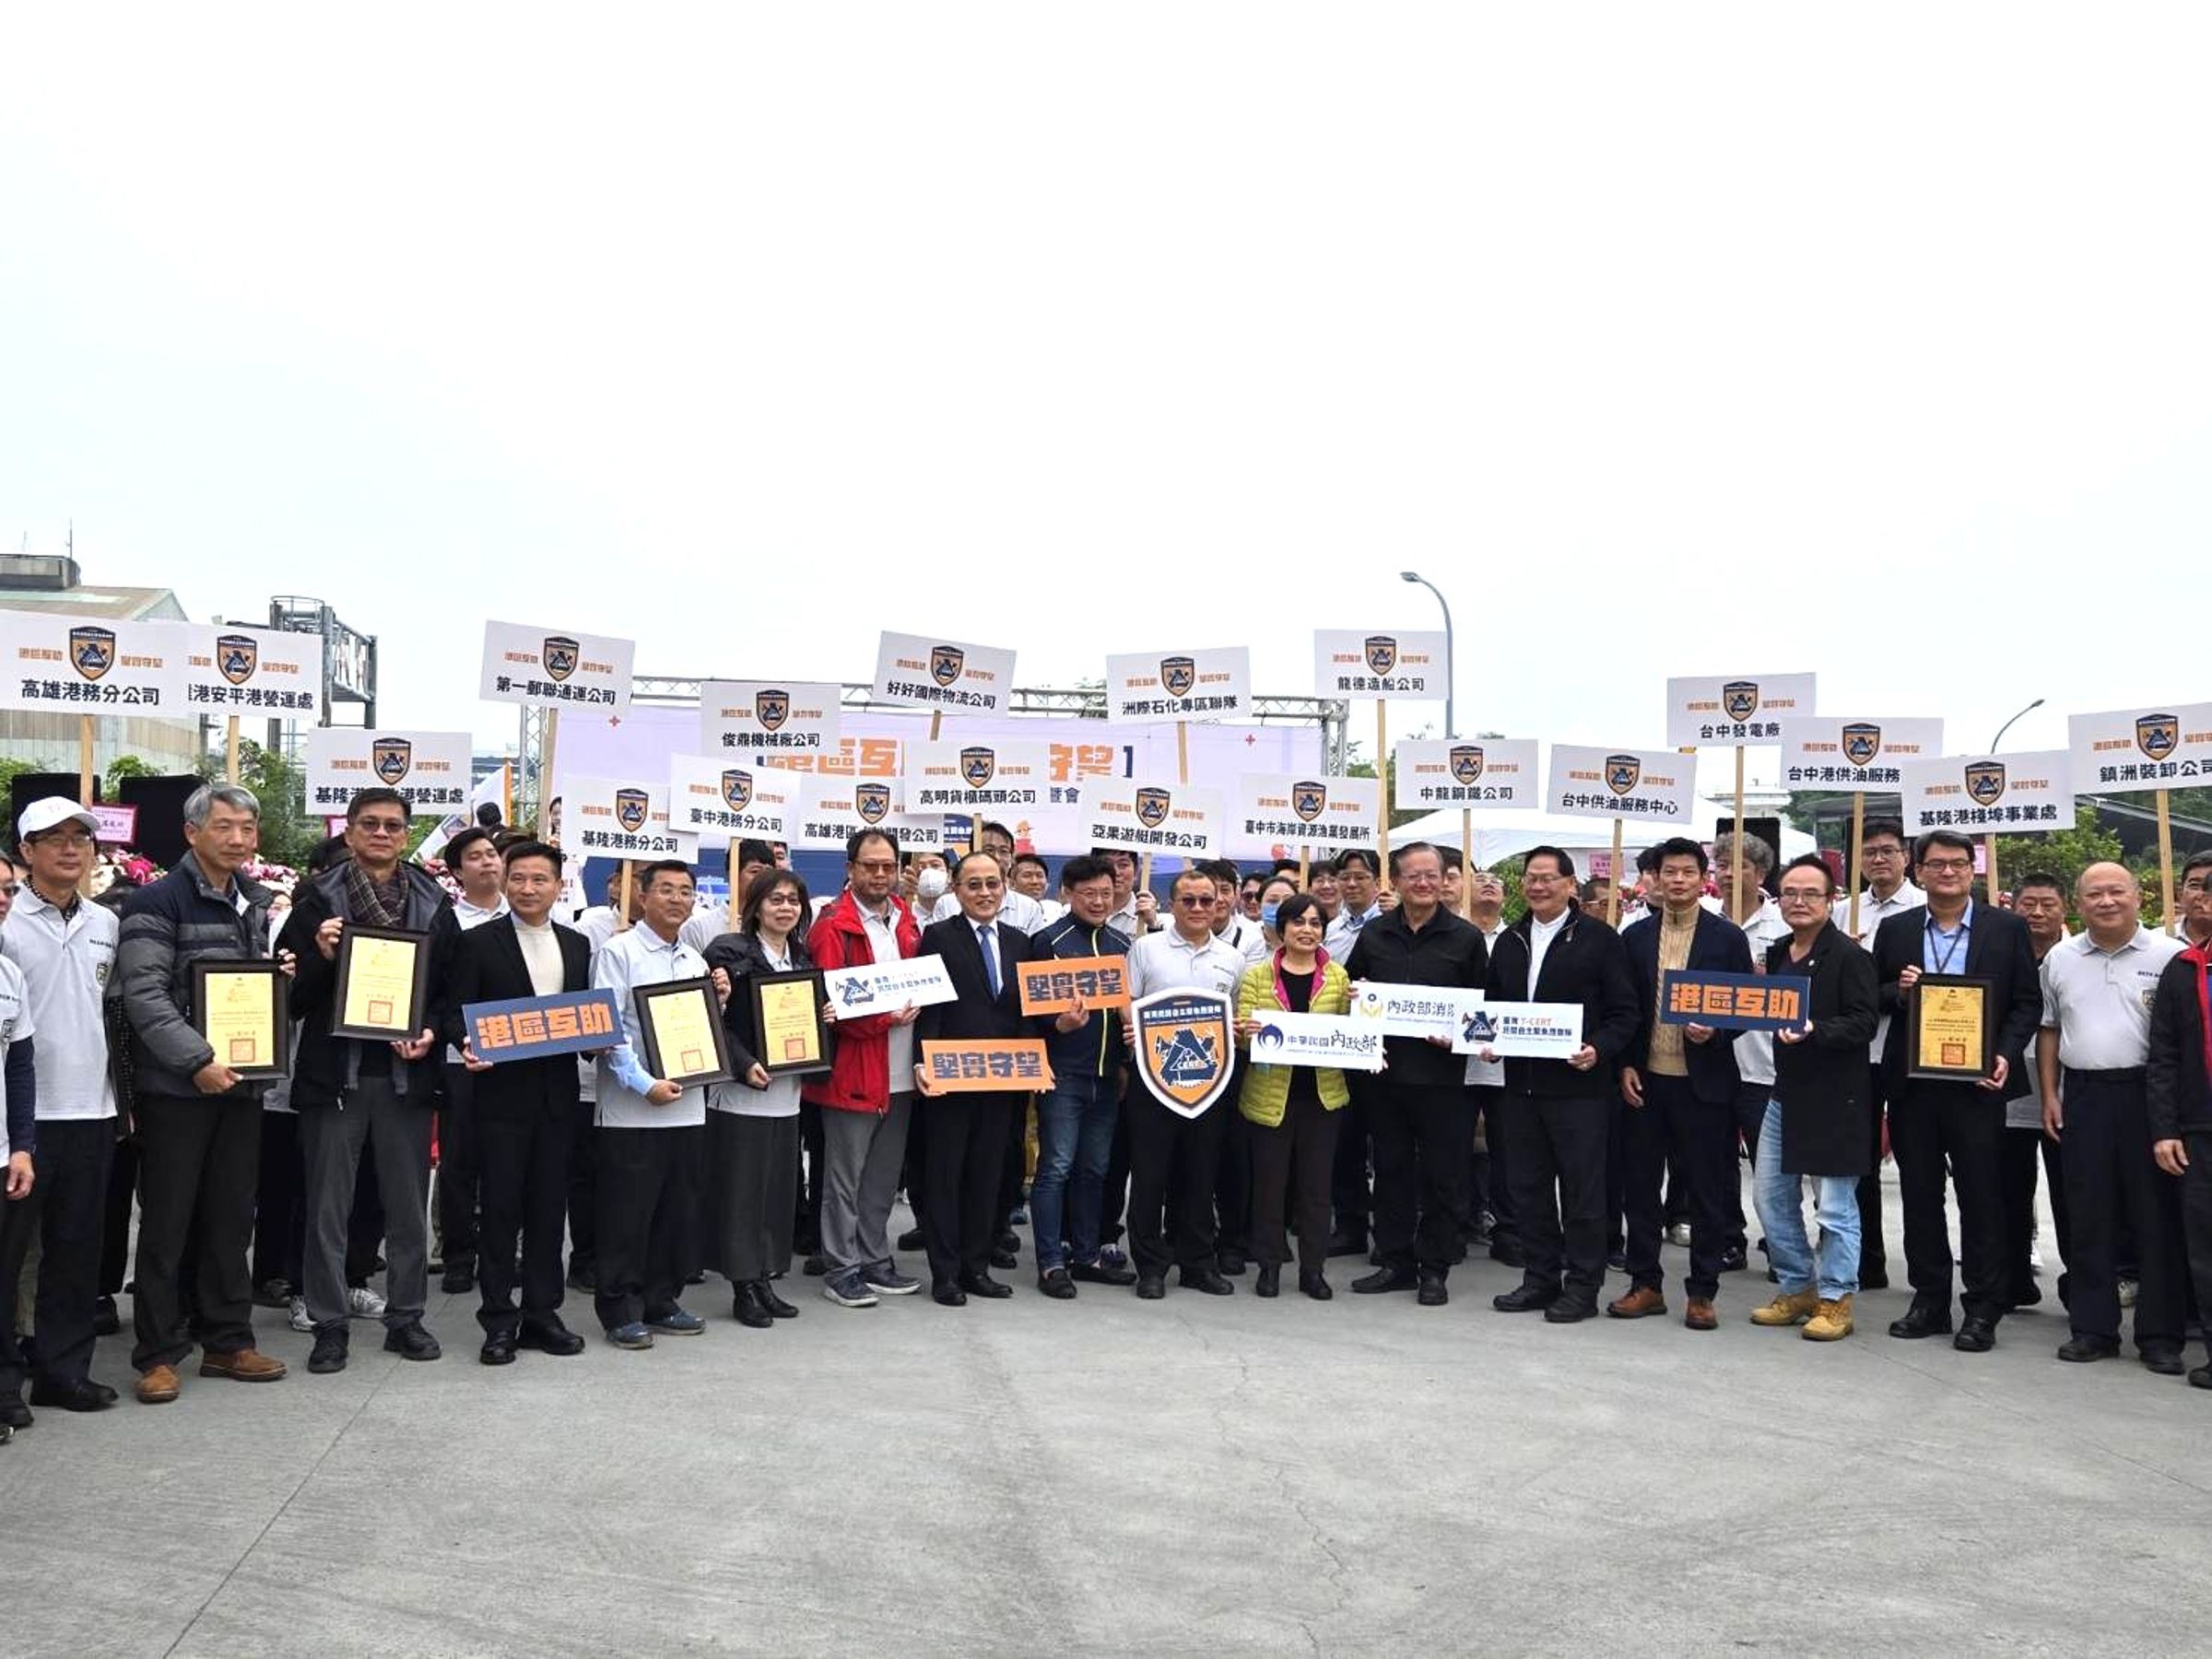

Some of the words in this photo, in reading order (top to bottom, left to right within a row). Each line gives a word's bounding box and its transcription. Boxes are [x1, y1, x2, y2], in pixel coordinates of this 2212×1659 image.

[21, 679, 160, 706] 高雄港務分公司
[888, 680, 996, 710] 好好國際物流公司
[1337, 677, 1425, 691] 龍德造船公司
[188, 683, 314, 710] 港安平港營運處
[1122, 695, 1238, 716] 洲際石化專區聯隊
[722, 733, 821, 748] 俊鼎機械廠公司
[1700, 723, 1780, 739] 台中發電廠
[1787, 767, 1900, 783] 台中港供油服務
[920, 789, 1037, 804] 高明貨櫃碼頭公司
[1419, 786, 1513, 801] 中龍鋼鐵公司
[1561, 793, 1678, 815] 台中供油服務中心
[689, 808, 782, 832] 臺中港務分公司
[1919, 804, 2057, 828] 基隆港棧埠事業處
[582, 830, 678, 853] 基隆港務分公司
[1091, 824, 1207, 850] 亞果遊艇開發公司
[1026, 968, 1124, 1003] 堅實守望
[1669, 981, 1800, 1021] 港區互助
[476, 1003, 614, 1050] 港區互助
[932, 1051, 1042, 1079] 堅實守望
